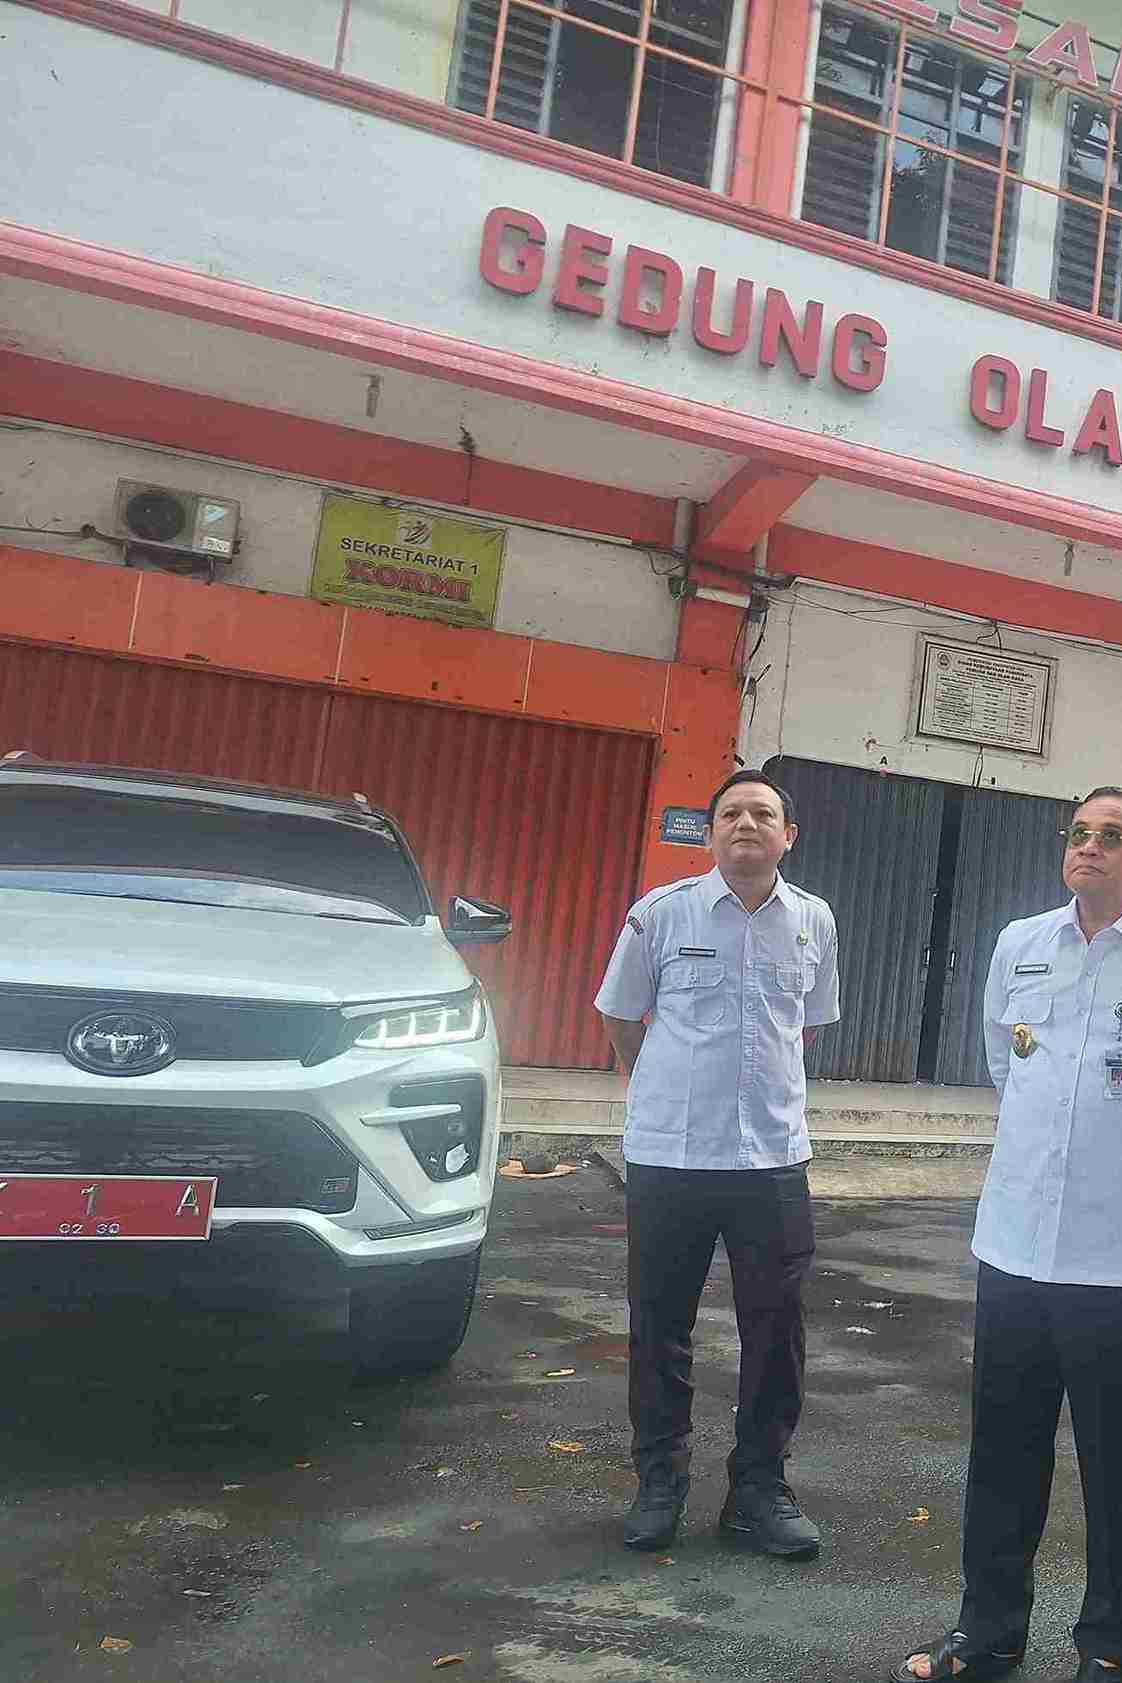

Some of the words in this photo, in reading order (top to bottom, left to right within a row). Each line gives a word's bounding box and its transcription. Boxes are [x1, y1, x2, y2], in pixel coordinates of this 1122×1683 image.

[479, 206, 888, 393] GEDUNG
[340, 537, 465, 574] SEKRETARIAT
[467, 563, 479, 576] 1
[175, 1184, 201, 1217] A
